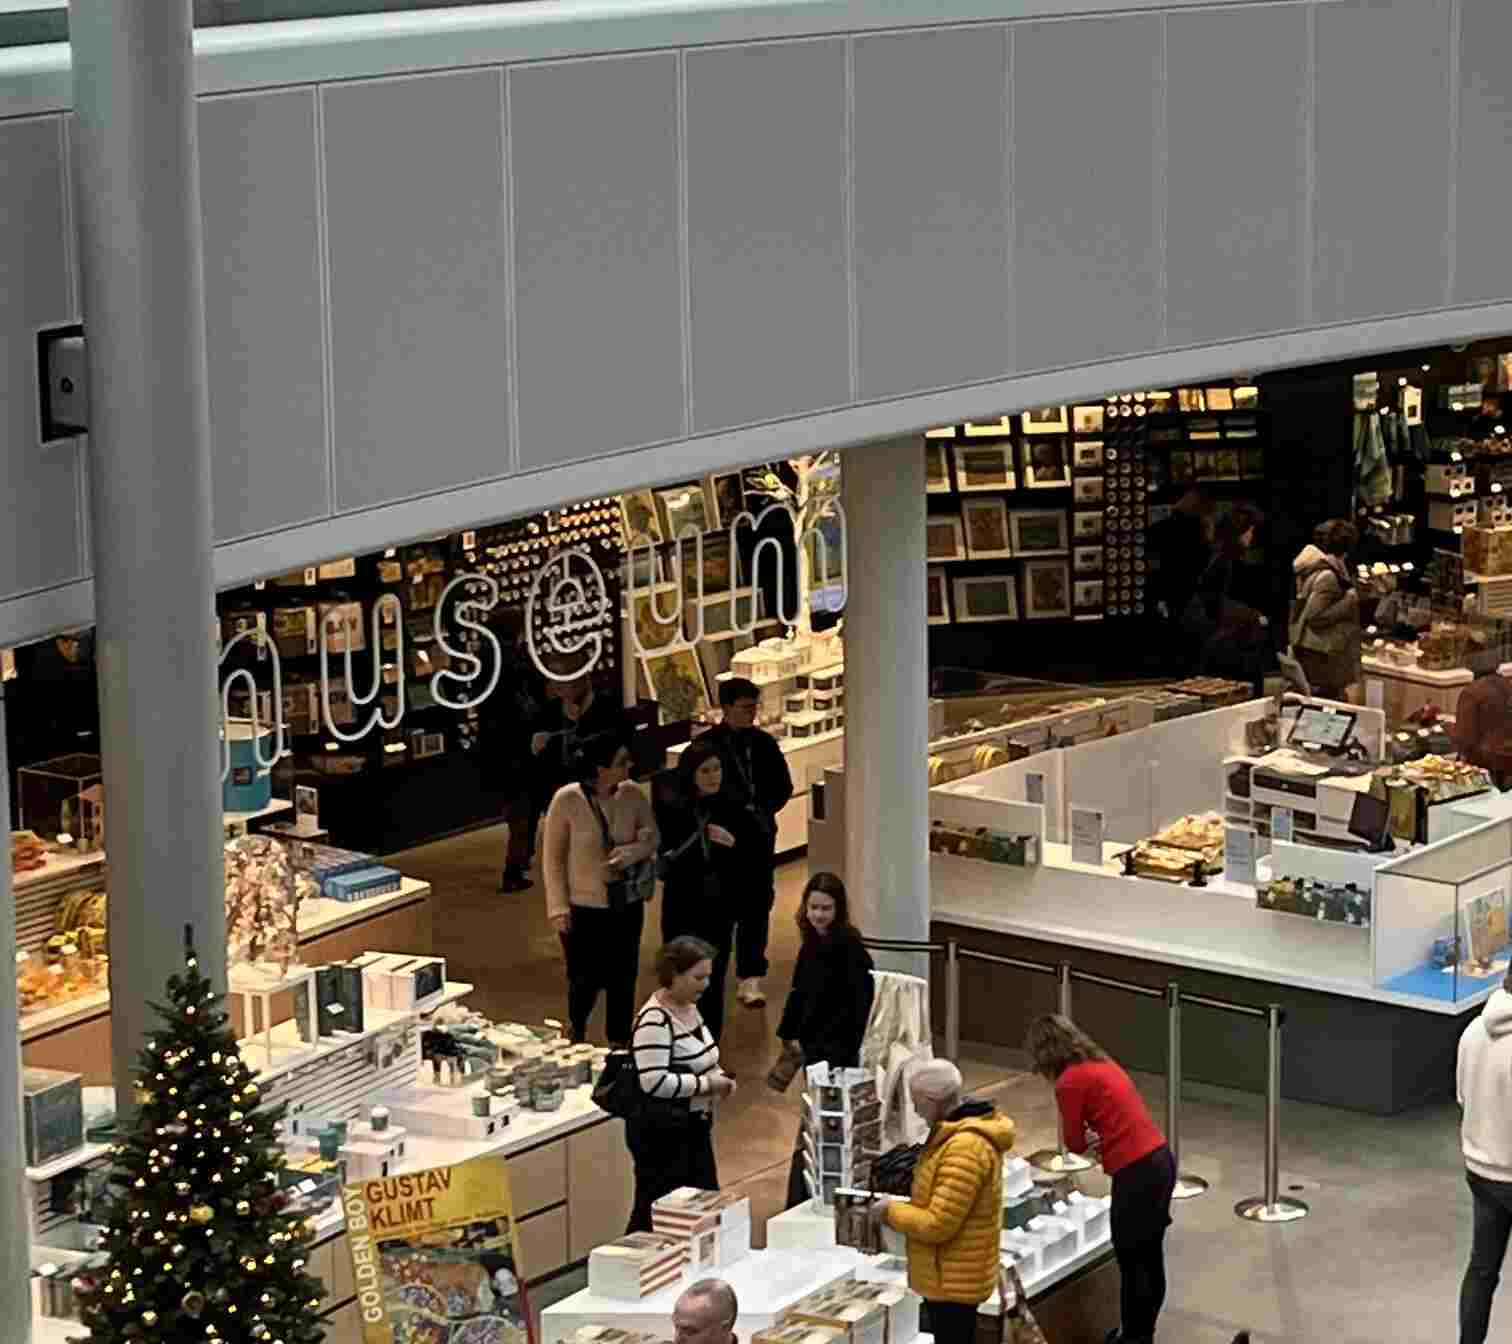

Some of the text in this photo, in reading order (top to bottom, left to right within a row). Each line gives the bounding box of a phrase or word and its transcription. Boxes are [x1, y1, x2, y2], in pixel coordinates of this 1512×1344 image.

[366, 1166, 452, 1204] GUSTAV
[370, 1197, 435, 1230] KLIMT
[343, 1187, 383, 1324] GOLDEN BOY
